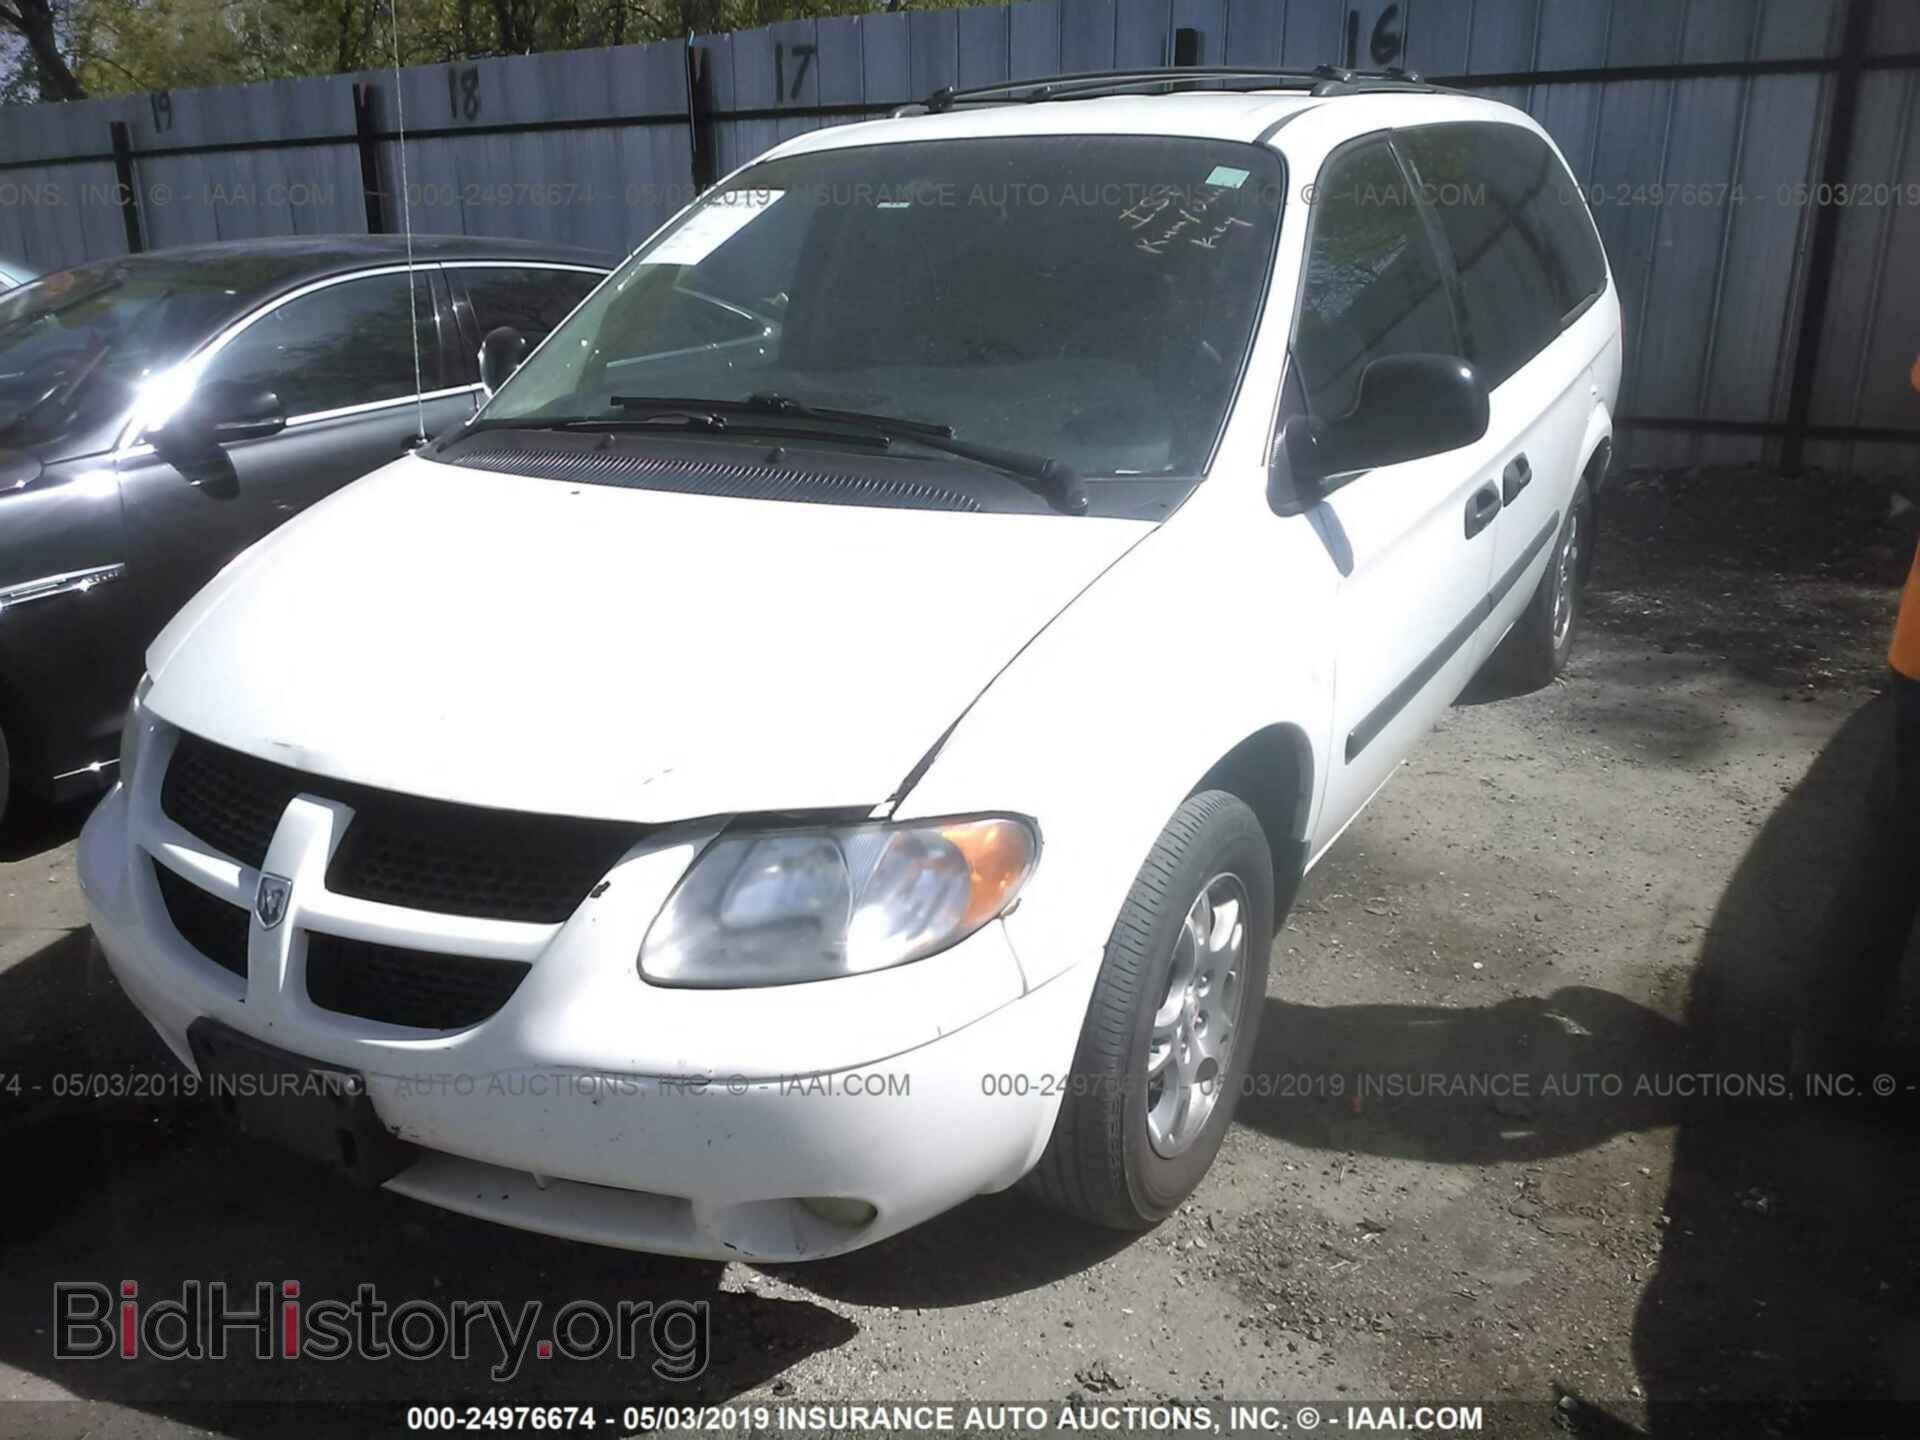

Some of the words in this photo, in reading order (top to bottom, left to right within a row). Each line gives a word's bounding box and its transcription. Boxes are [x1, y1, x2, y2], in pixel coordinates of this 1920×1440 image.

[1345, 4, 1404, 68] 16
[448, 66, 480, 121] 18
[775, 43, 816, 103] 17
[151, 92, 172, 133] 19
